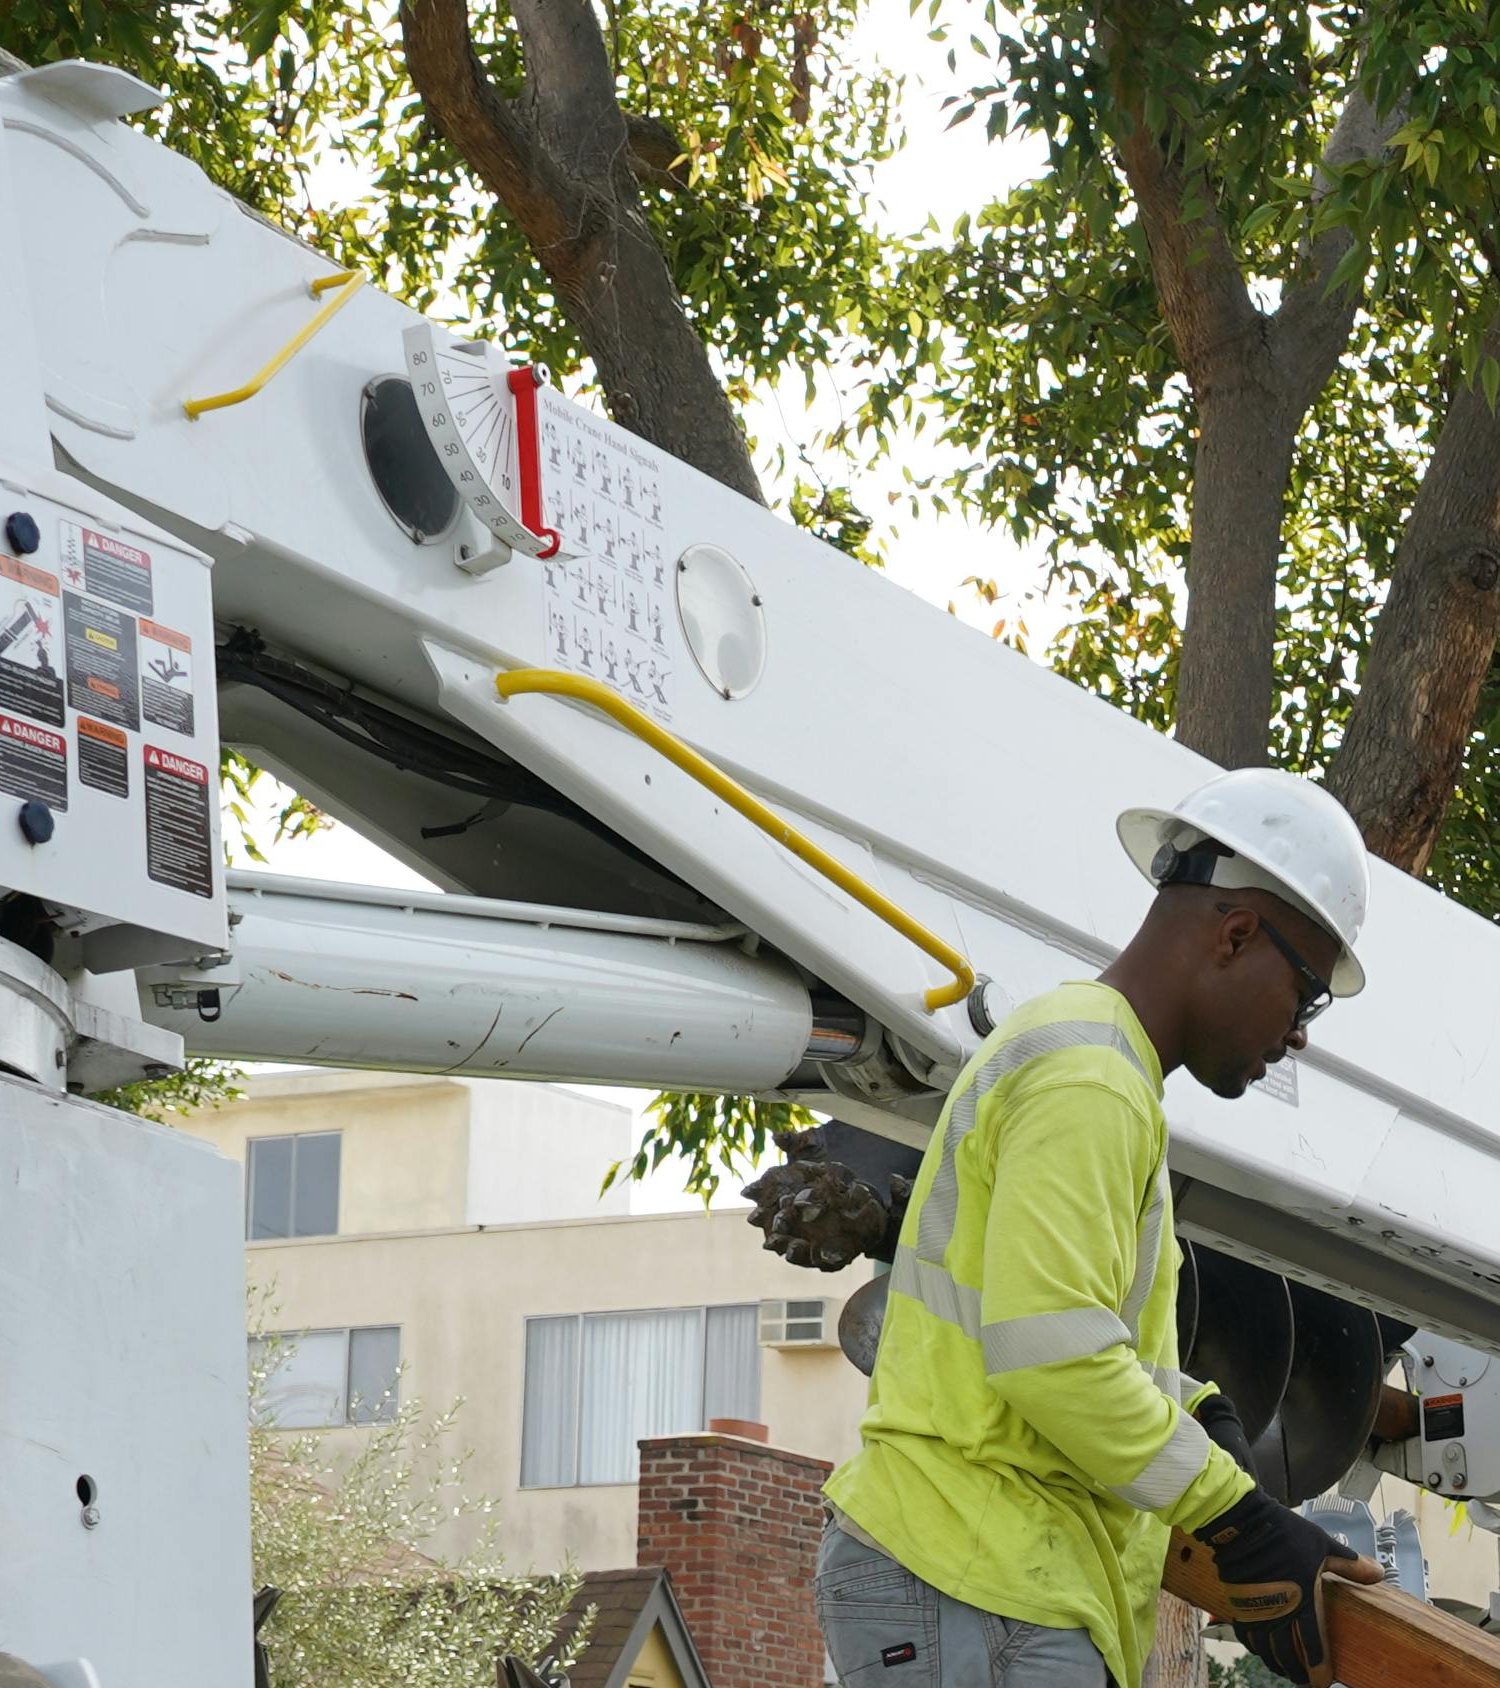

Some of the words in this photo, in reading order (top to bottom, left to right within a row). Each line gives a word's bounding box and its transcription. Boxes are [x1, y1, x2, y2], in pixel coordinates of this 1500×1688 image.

[413, 351, 428, 366] 80
[421, 382, 435, 396] 70
[432, 413, 446, 427] 60
[544, 399, 573, 425] Mobile
[575, 418, 604, 441] Crane
[605, 433, 628, 455] Hand
[630, 448, 659, 472] Signals
[444, 443, 459, 456] 50
[460, 470, 474, 482] 40
[501, 474, 511, 490] 10
[474, 494, 490, 506] 30
[491, 516, 508, 527] 20
[101, 535, 143, 565] DANGER
[13, 723, 61, 750] DANGER
[162, 754, 204, 780] DANGER
